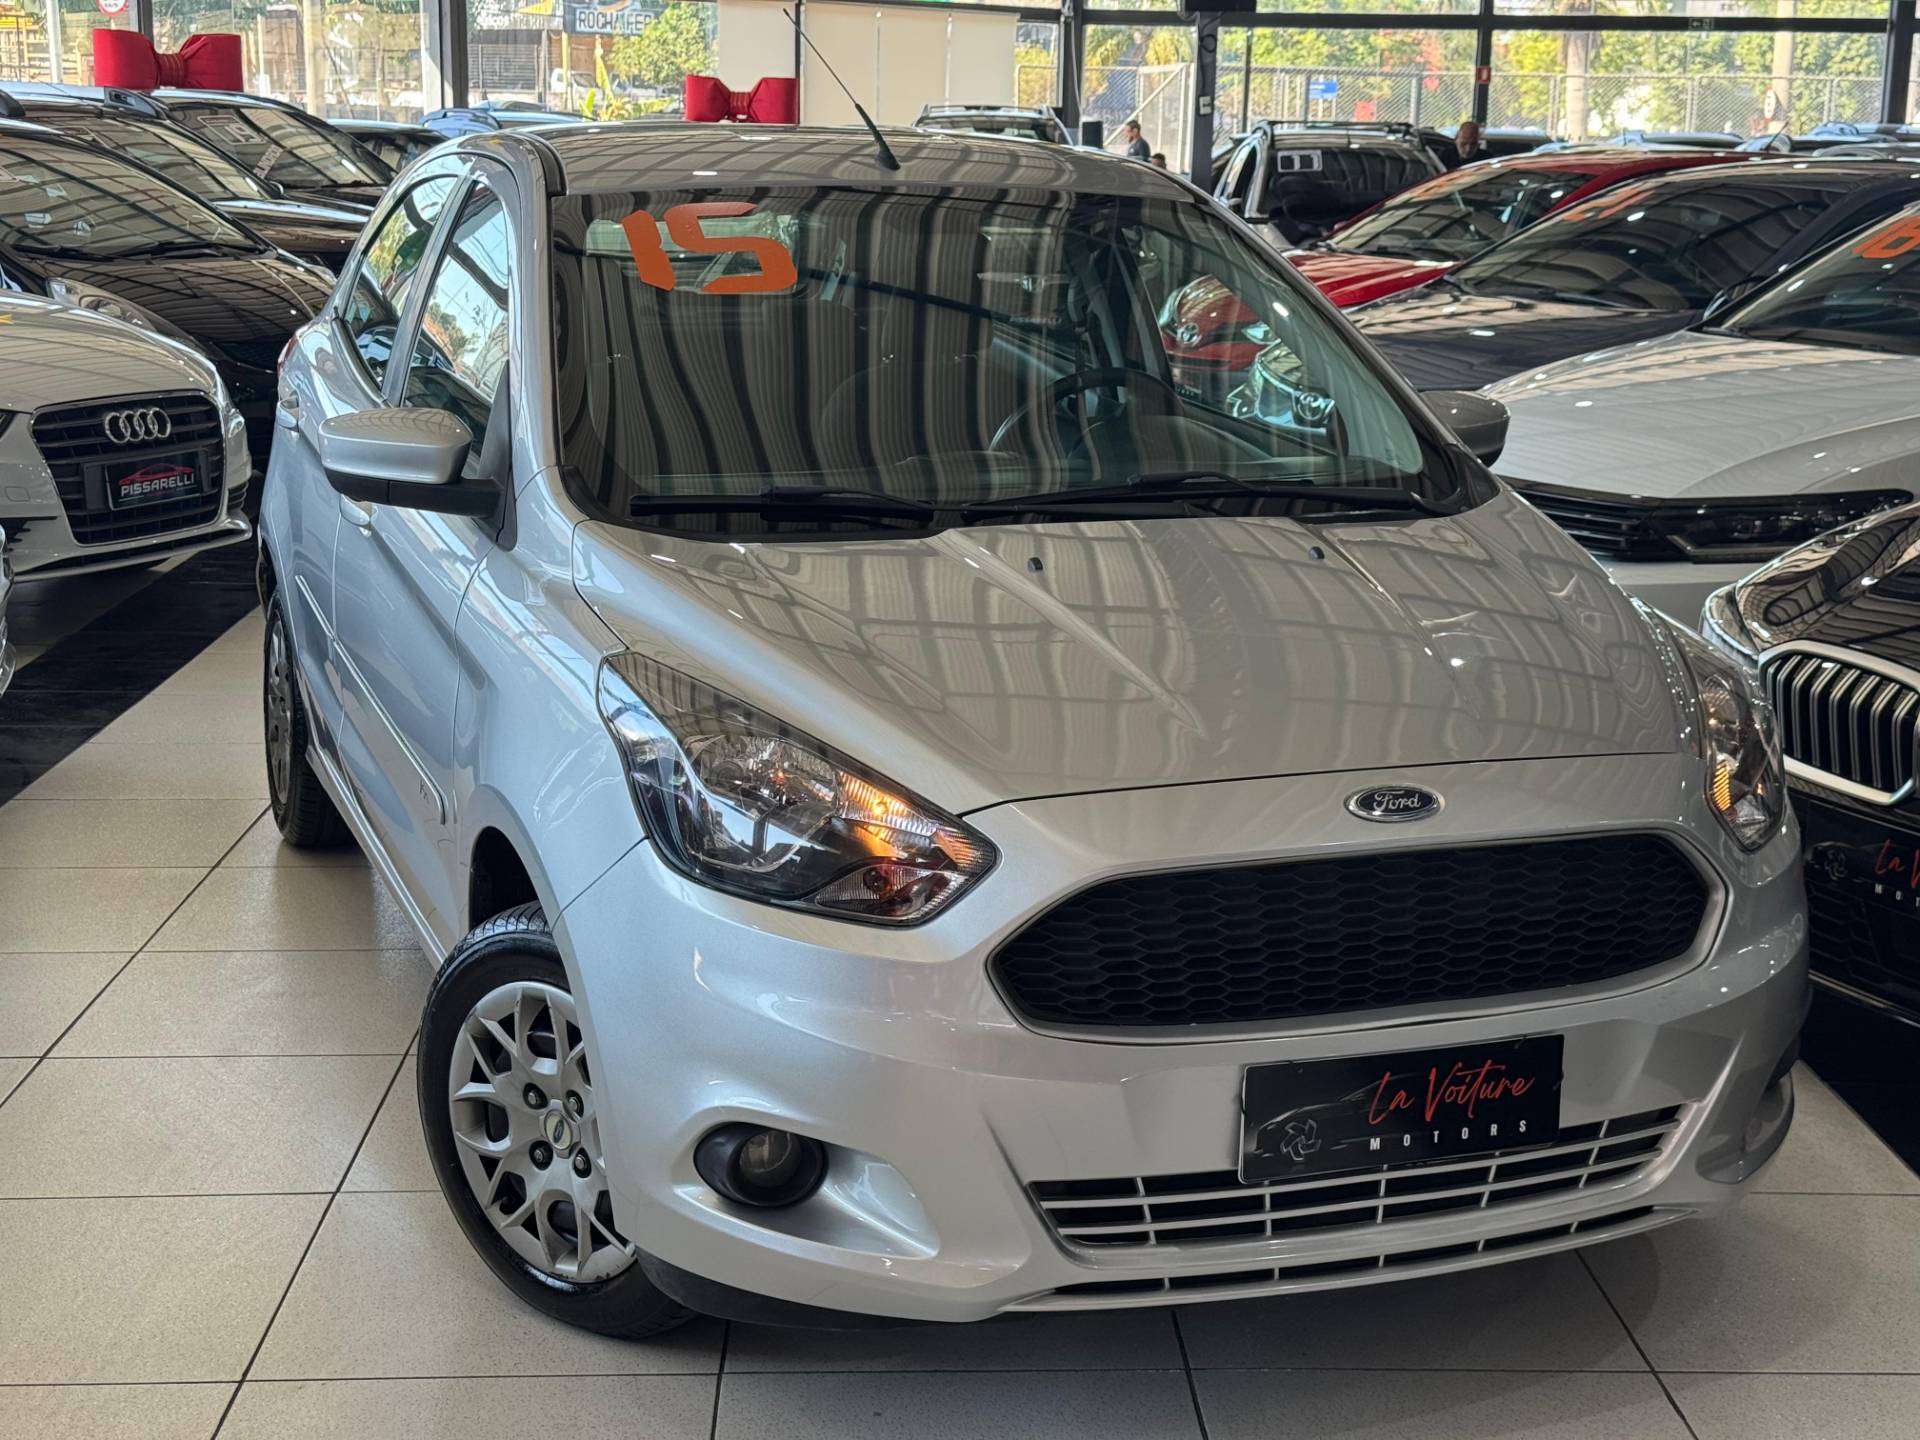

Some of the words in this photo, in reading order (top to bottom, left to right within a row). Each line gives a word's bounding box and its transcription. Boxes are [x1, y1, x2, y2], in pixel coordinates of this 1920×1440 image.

[622, 201, 798, 294] 15
[120, 472, 195, 497] PISSARELLI
[1373, 790, 1421, 812] Ford
[1368, 1071, 1416, 1125] La
[1424, 1059, 1536, 1122] Voiture
[1369, 1119, 1527, 1151] MOTORS
